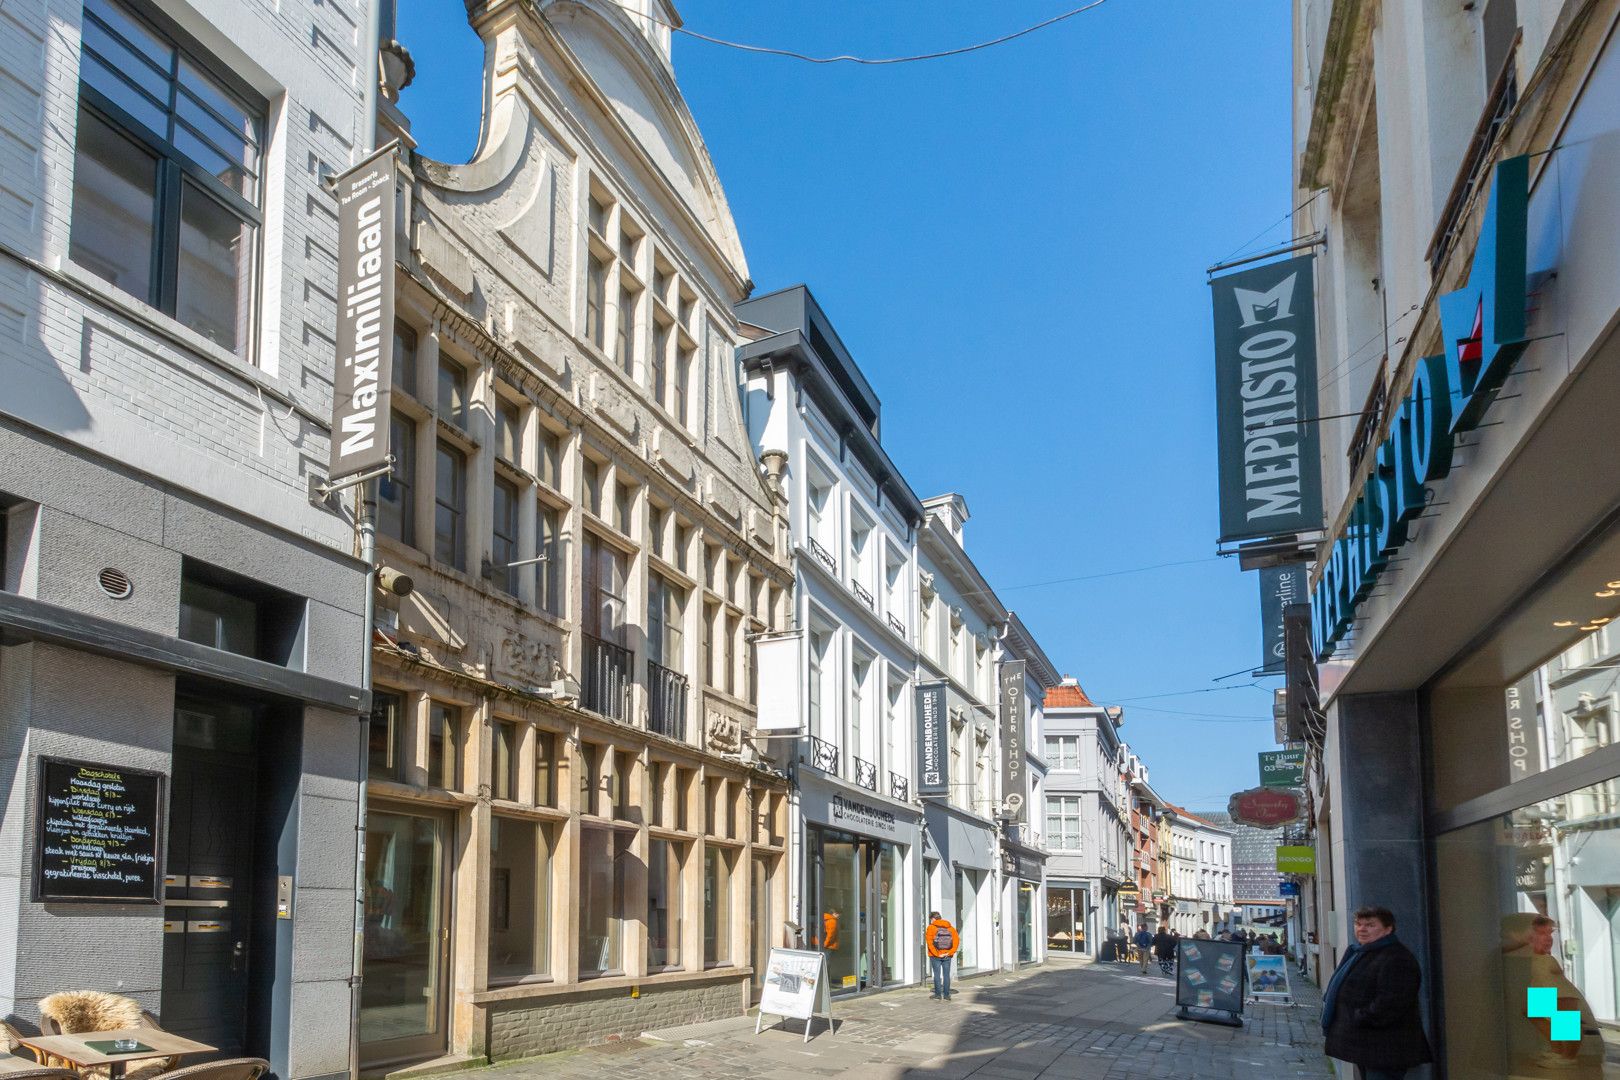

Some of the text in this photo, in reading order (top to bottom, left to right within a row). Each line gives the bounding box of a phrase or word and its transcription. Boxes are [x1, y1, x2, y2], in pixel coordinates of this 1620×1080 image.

[372, 173, 390, 188] Snack
[339, 195, 381, 460] Maximiliaan
[1239, 329, 1302, 523] MEPHISTO
[1311, 354, 1440, 664] MEPHISTO
[923, 691, 934, 772] VANDENBOUHEDE
[932, 725, 940, 772] CHOCOLATERIE
[1004, 672, 1022, 781] THE OTHER SHOP
[843, 798, 896, 825] VANDENBOUHEDE
